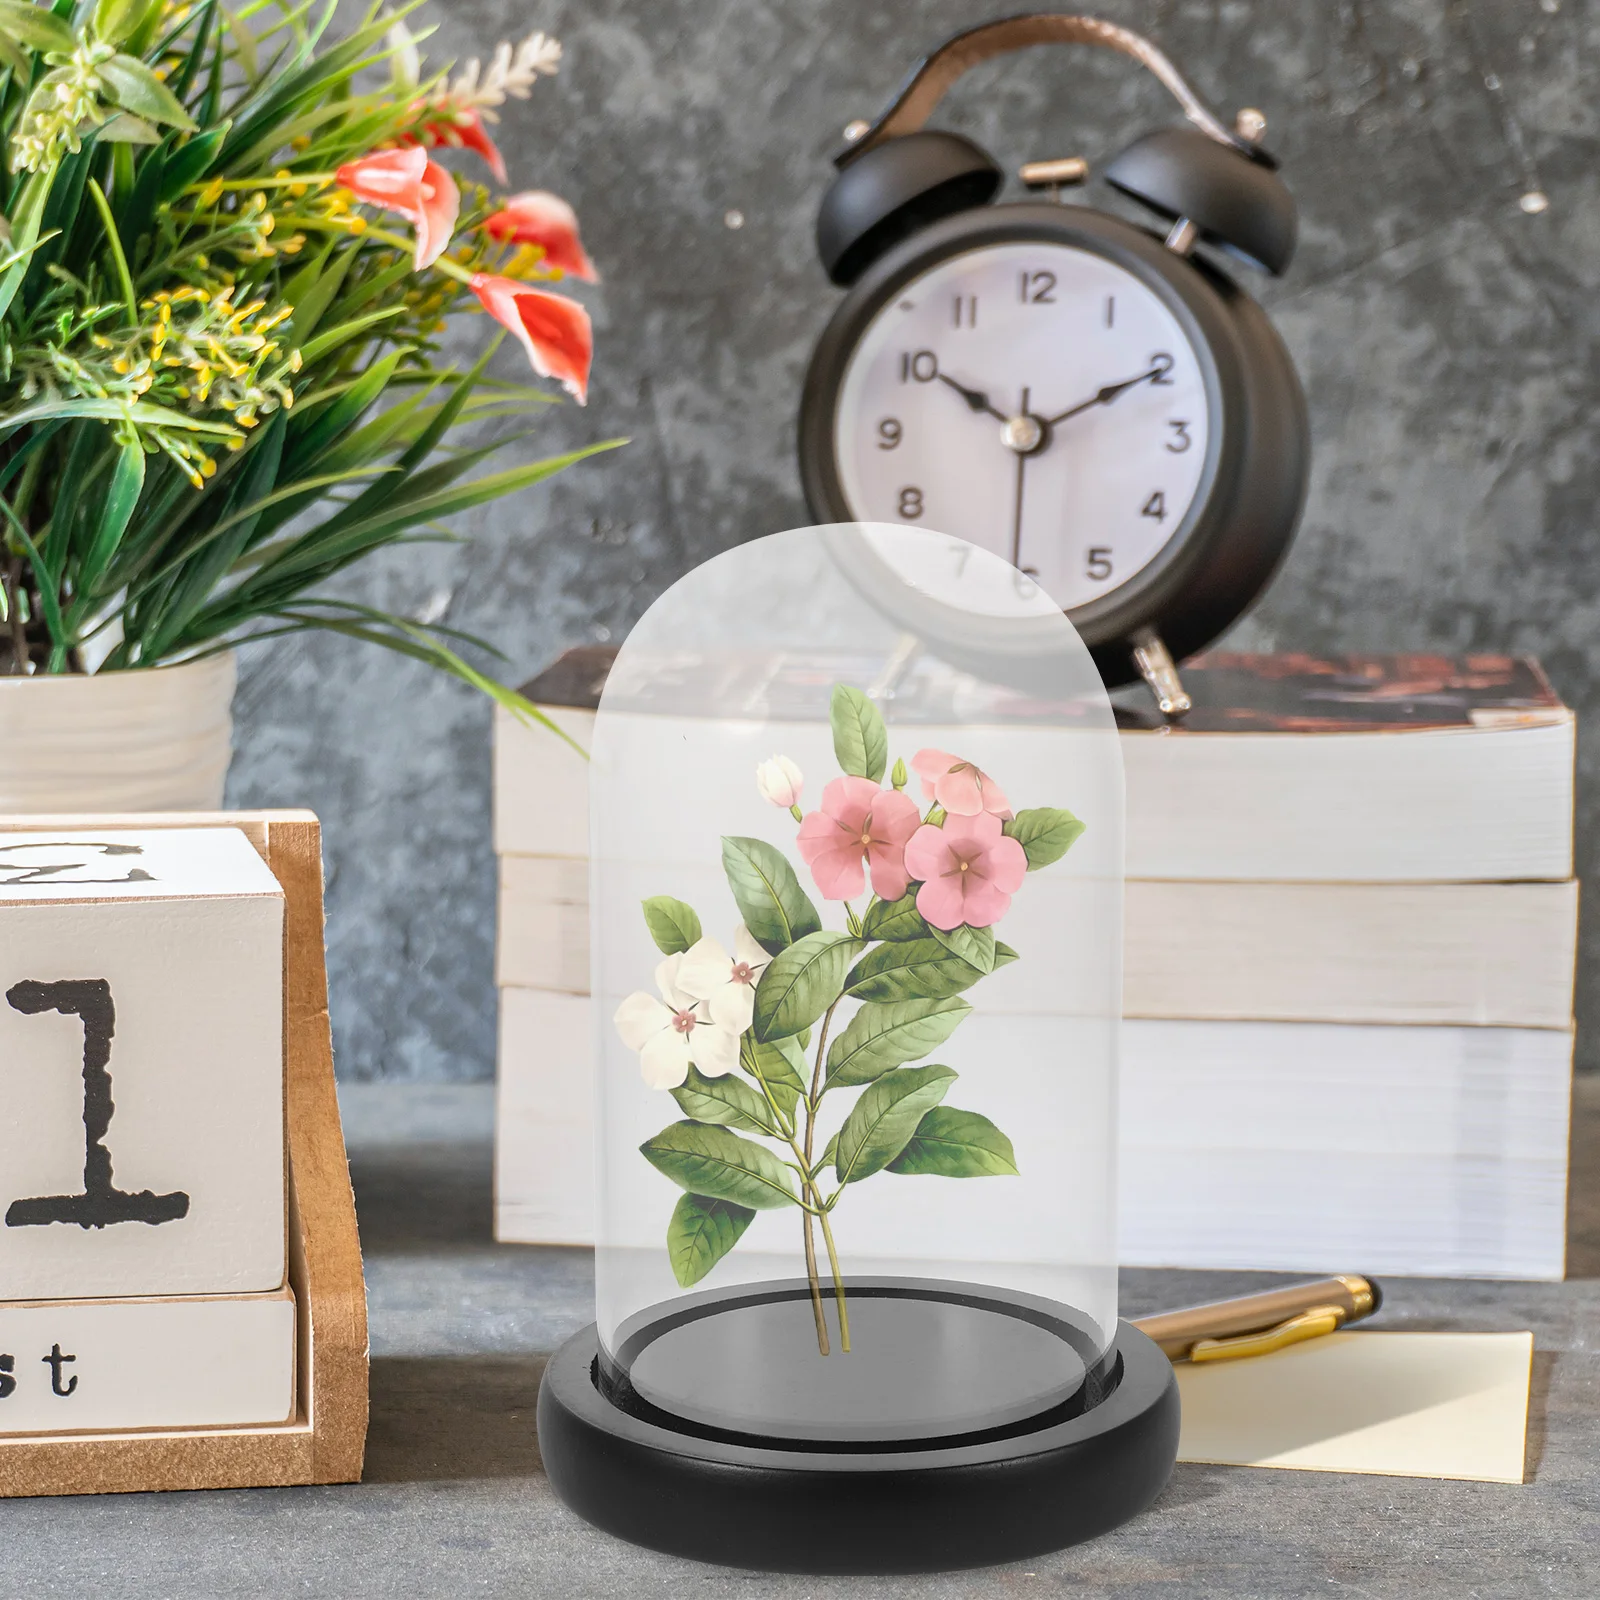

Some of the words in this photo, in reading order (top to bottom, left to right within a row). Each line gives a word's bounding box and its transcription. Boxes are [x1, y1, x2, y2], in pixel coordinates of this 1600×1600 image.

[1021, 271, 1057, 303] 12
[954, 295, 977, 328] 11
[1106, 296, 1115, 329] 1
[902, 351, 938, 382] 10
[1149, 352, 1174, 386] 2
[877, 417, 902, 450] 9
[1166, 420, 1191, 453] 3
[899, 486, 923, 519] 8
[1141, 490, 1166, 523] 4
[948, 545, 970, 579] 7
[1086, 548, 1113, 581] 5
[1012, 567, 1039, 600] 6
[5, 978, 190, 1230] 1
